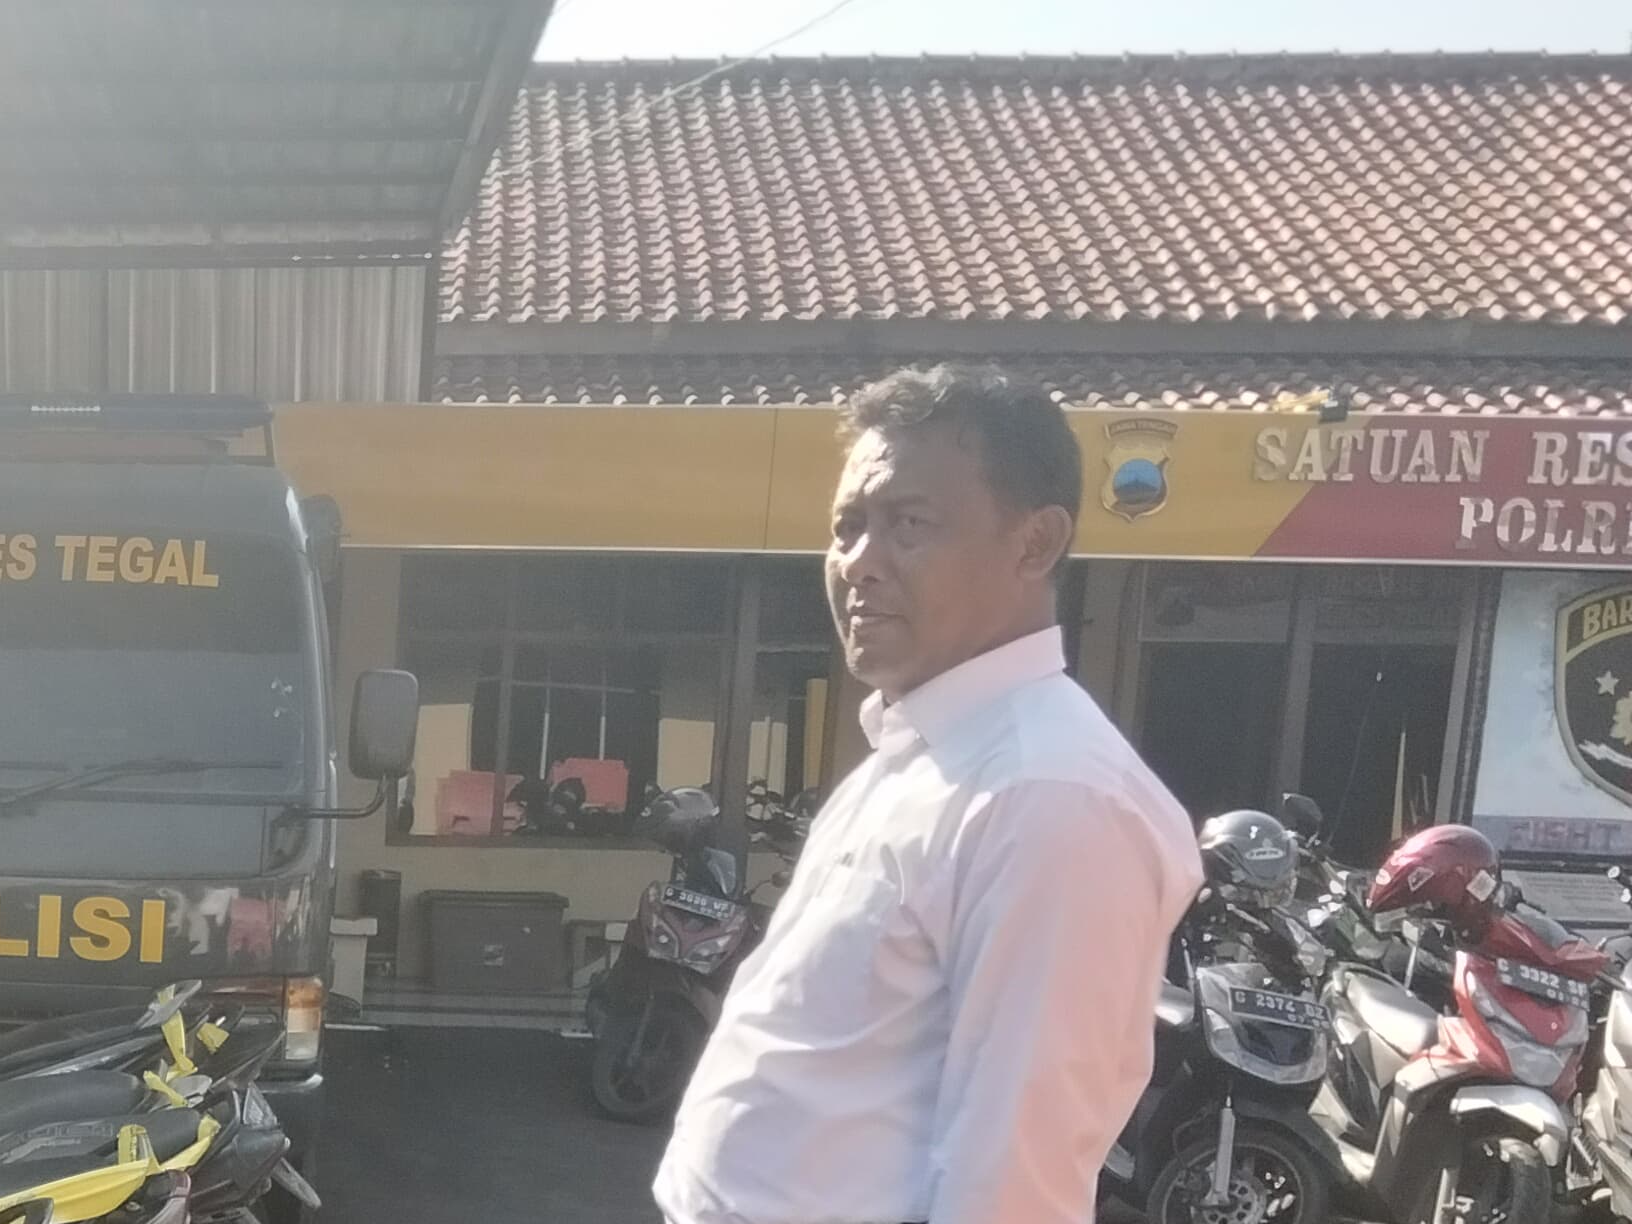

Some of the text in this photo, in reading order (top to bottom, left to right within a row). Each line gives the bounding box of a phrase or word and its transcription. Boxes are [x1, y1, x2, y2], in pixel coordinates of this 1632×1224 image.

[1254, 428, 1490, 483] SATUAN
[1456, 497, 1632, 554] POLR
[55, 536, 219, 588] TEGAL
